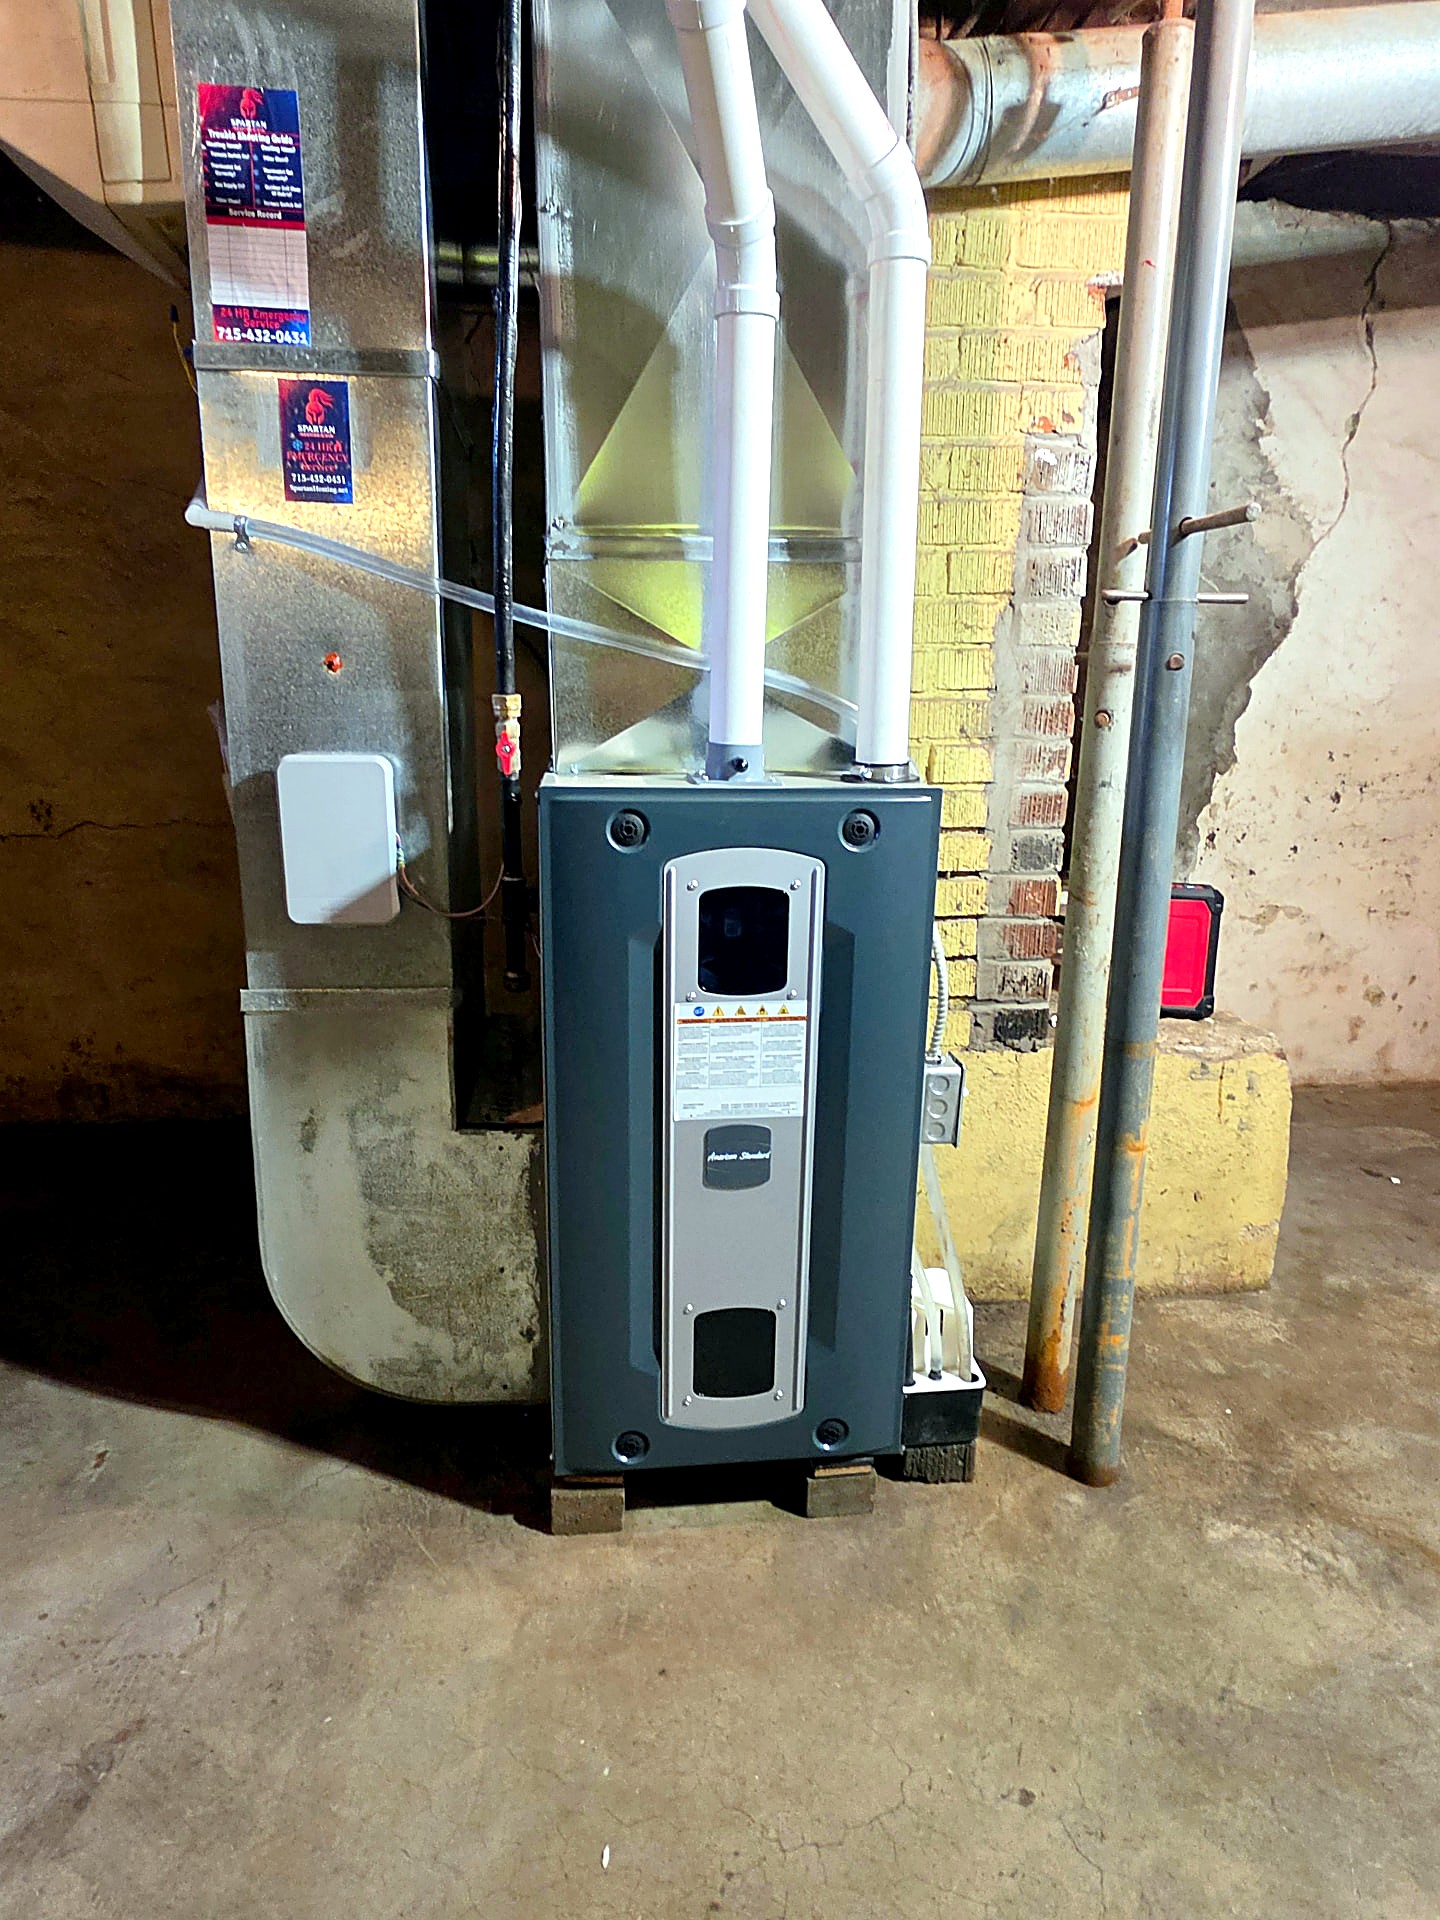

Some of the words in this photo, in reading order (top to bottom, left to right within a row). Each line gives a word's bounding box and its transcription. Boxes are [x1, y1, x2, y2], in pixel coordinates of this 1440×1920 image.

[230, 118, 267, 129] SPARTAN
[207, 128, 236, 140] Trouble
[271, 133, 293, 145] Guide
[228, 208, 256, 218] Service
[256, 209, 282, 220] Record
[220, 307, 232, 317] 24
[235, 308, 249, 319] HR
[253, 308, 307, 323] Emergency
[243, 318, 280, 329] Service
[216, 326, 308, 344] 715-432-0431
[297, 424, 336, 434] SPARTAN
[304, 441, 315, 450] 24
[318, 441, 333, 451] HR
[287, 450, 348, 462] EMERGENCY
[291, 473, 346, 484] 715-432-0431
